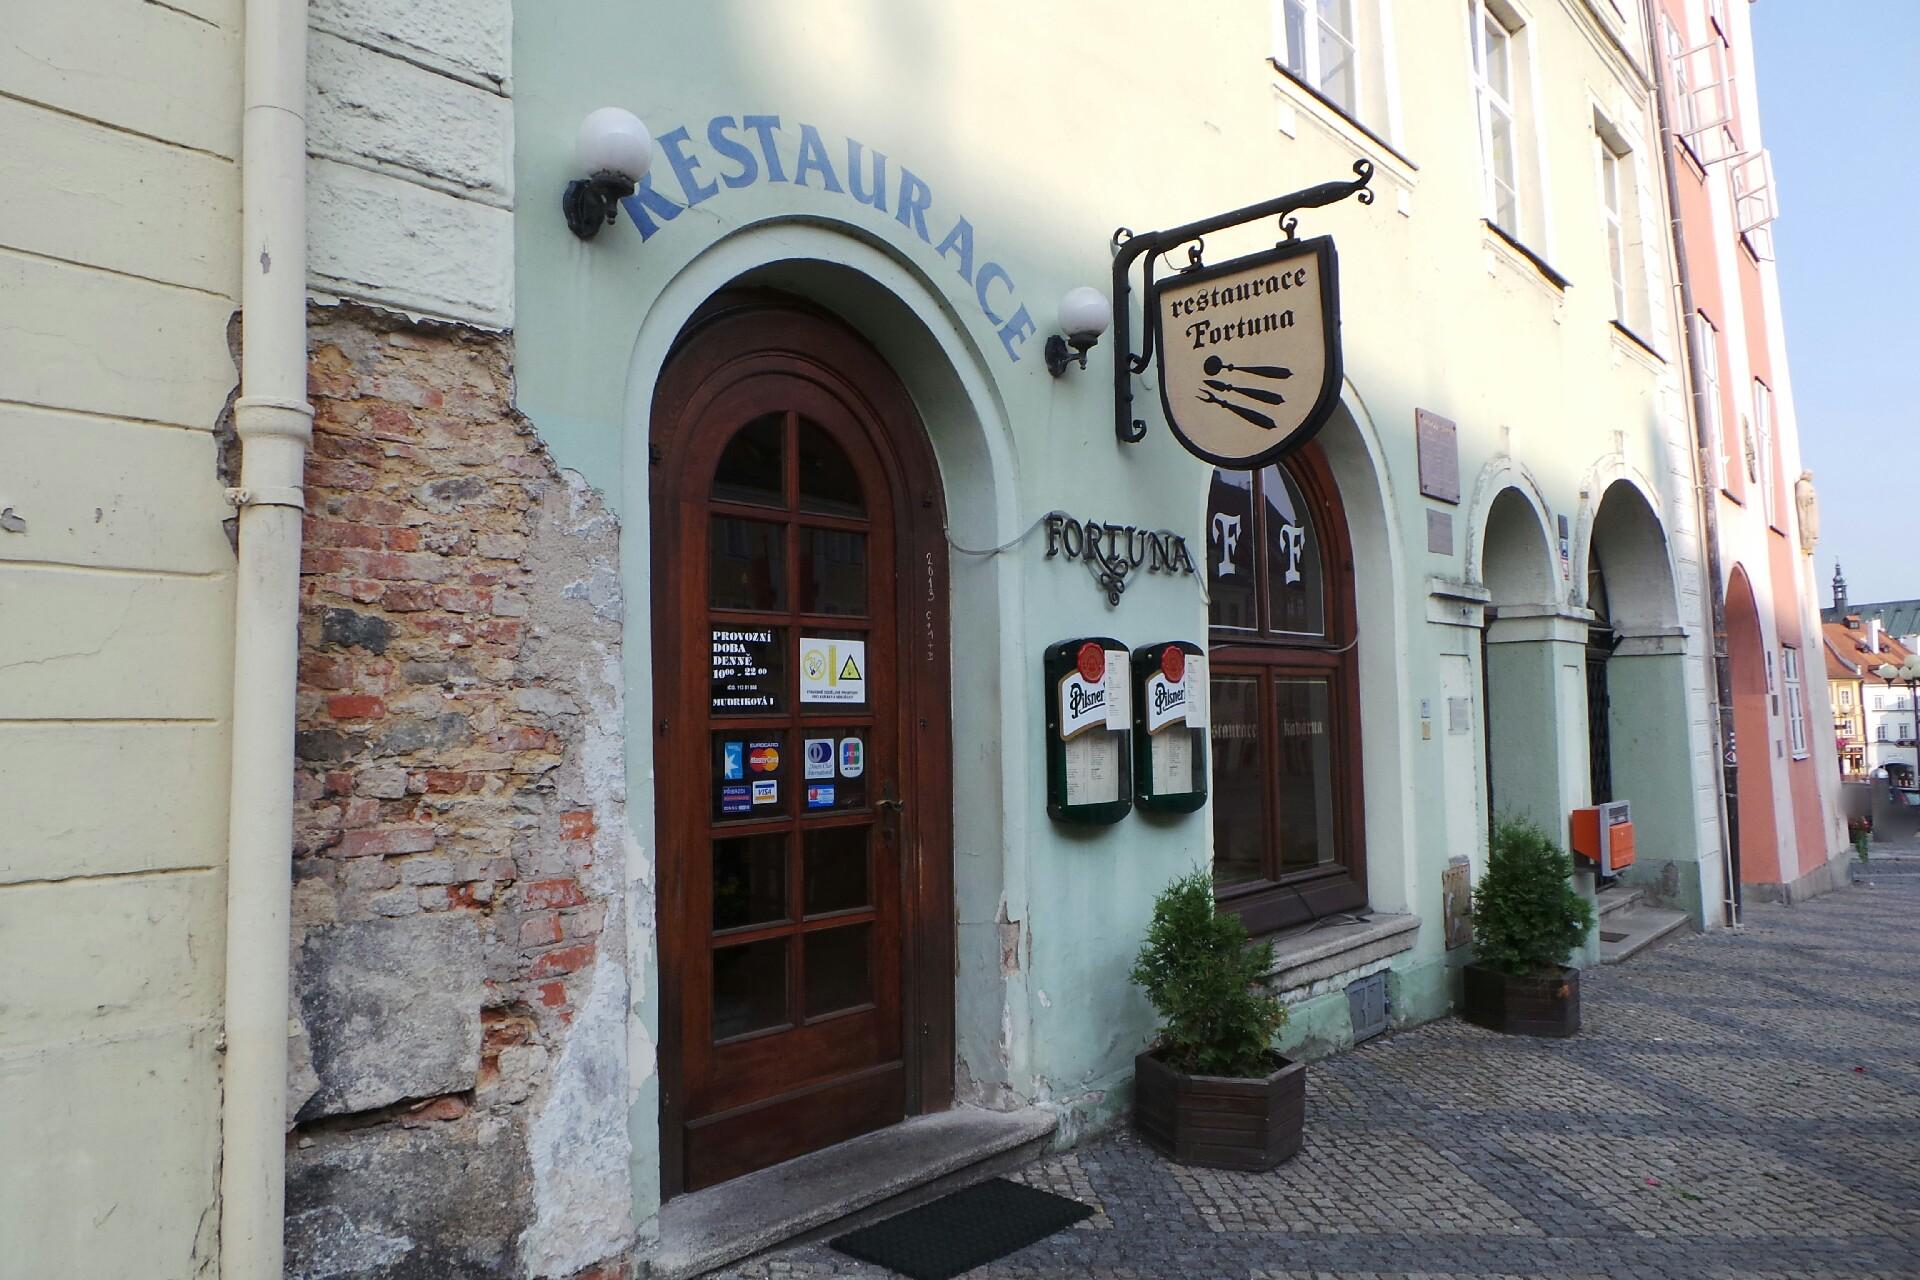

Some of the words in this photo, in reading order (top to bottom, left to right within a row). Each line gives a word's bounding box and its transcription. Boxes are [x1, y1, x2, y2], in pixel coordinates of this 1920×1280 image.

[1171, 267, 1307, 318] restaurace
[1185, 309, 1295, 350] Fortuna
[1045, 512, 1195, 606] FORTUNA
[1212, 512, 1241, 578] F
[1280, 524, 1306, 585] F
[712, 629, 772, 643] PROVOZNÍ
[712, 643, 746, 653] DOBA
[712, 653, 753, 666] DENNĚ
[1069, 682, 1105, 720] Pilsner
[1154, 682, 1184, 716] Pilsner
[758, 788, 772, 796] VISA
